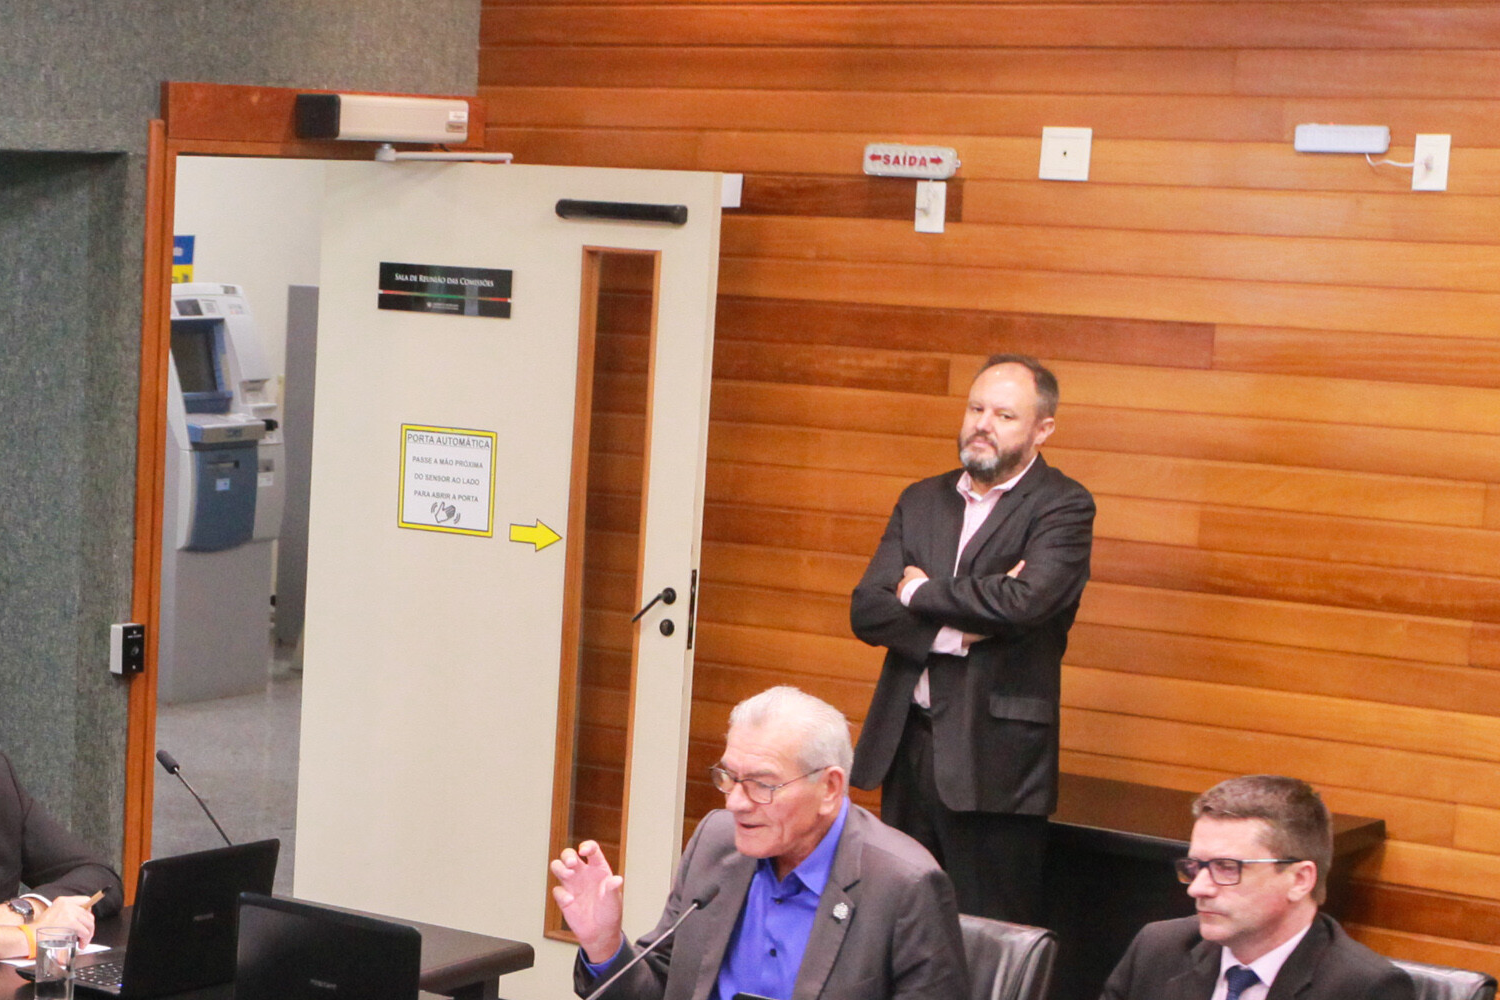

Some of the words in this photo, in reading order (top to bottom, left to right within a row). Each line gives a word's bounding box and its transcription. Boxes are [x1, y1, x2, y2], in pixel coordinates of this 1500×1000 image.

[883, 152, 927, 167] SAÍDA
[407, 433, 435, 443] PORTA
[436, 436, 490, 448] AUTOMÁTICA
[412, 456, 432, 464] PASSE
[439, 458, 454, 466] MÃO
[414, 472, 424, 480] DO
[425, 474, 451, 482] SENSOR
[462, 478, 480, 486] LADO
